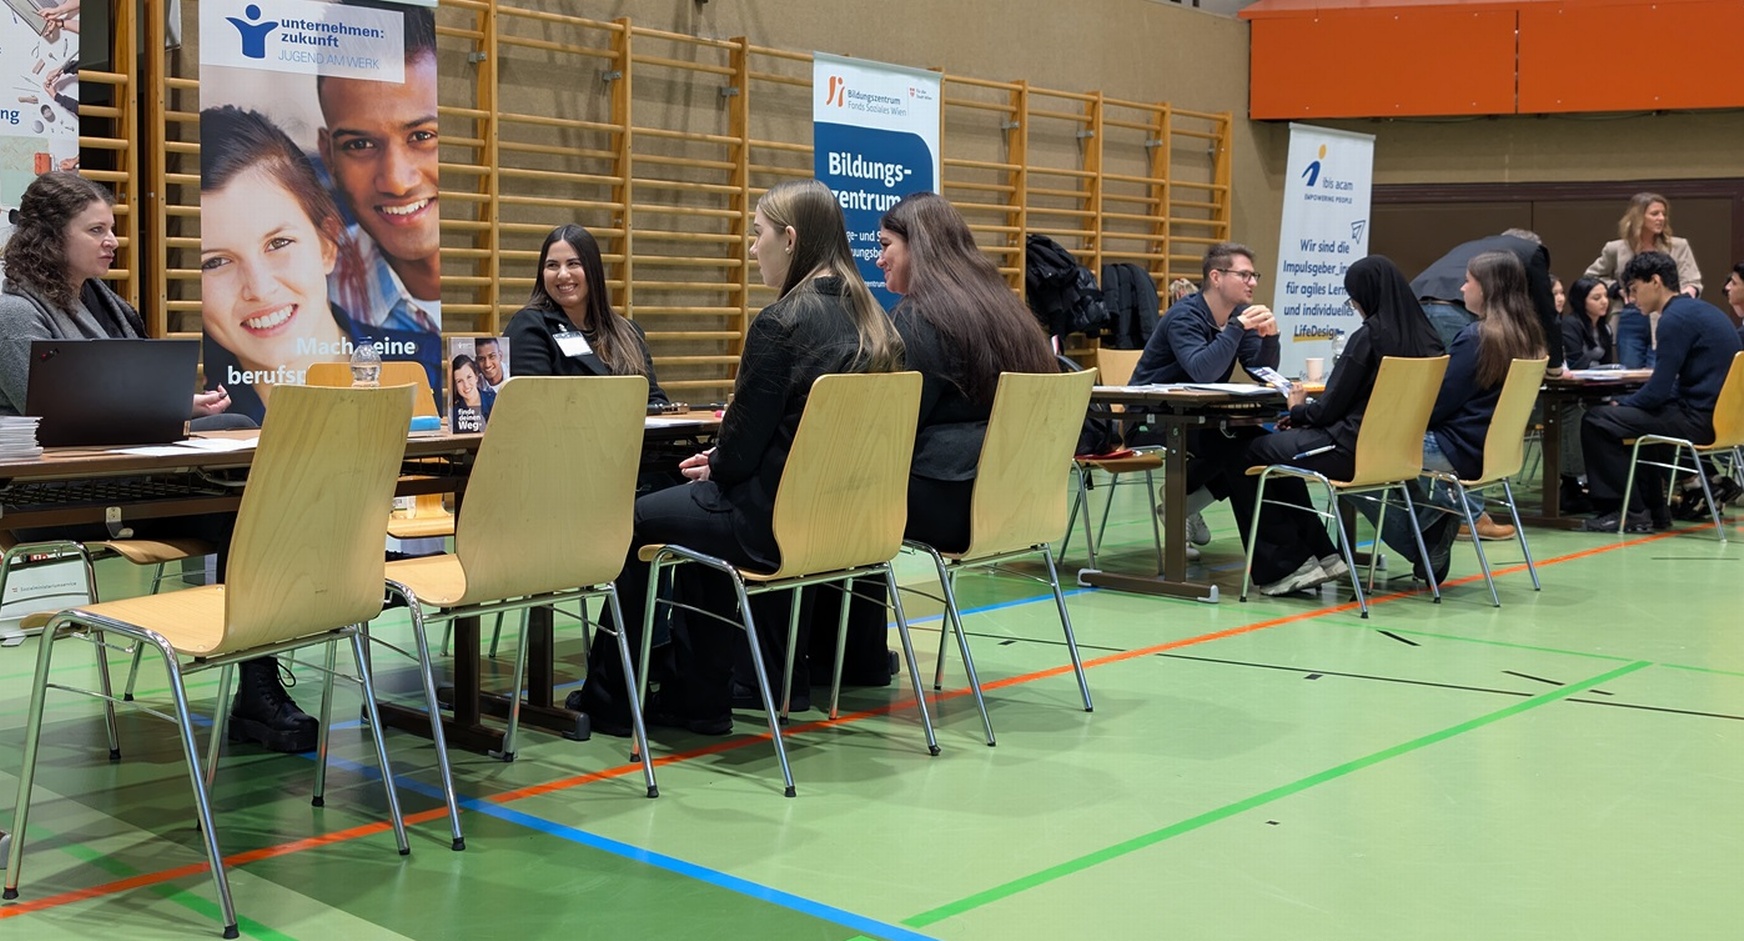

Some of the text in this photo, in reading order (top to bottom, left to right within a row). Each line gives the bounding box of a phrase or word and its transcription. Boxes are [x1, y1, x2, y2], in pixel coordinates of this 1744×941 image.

[281, 18, 384, 39] unternehmen:
[281, 32, 339, 48] zukunft
[278, 50, 380, 69] JUGEND AM WERK
[848, 89, 901, 105] Bildungszentrum
[848, 101, 907, 116] Fonds Soziales Wien
[828, 152, 912, 188] Bildungs-
[1323, 177, 1353, 190] ibis acam
[859, 229, 875, 242] und
[1300, 239, 1350, 254] Wir sind die
[1286, 282, 1299, 294] für
[1301, 283, 1326, 298] agiles
[1284, 303, 1354, 317] und individuelles
[296, 336, 416, 356] Mach eine
